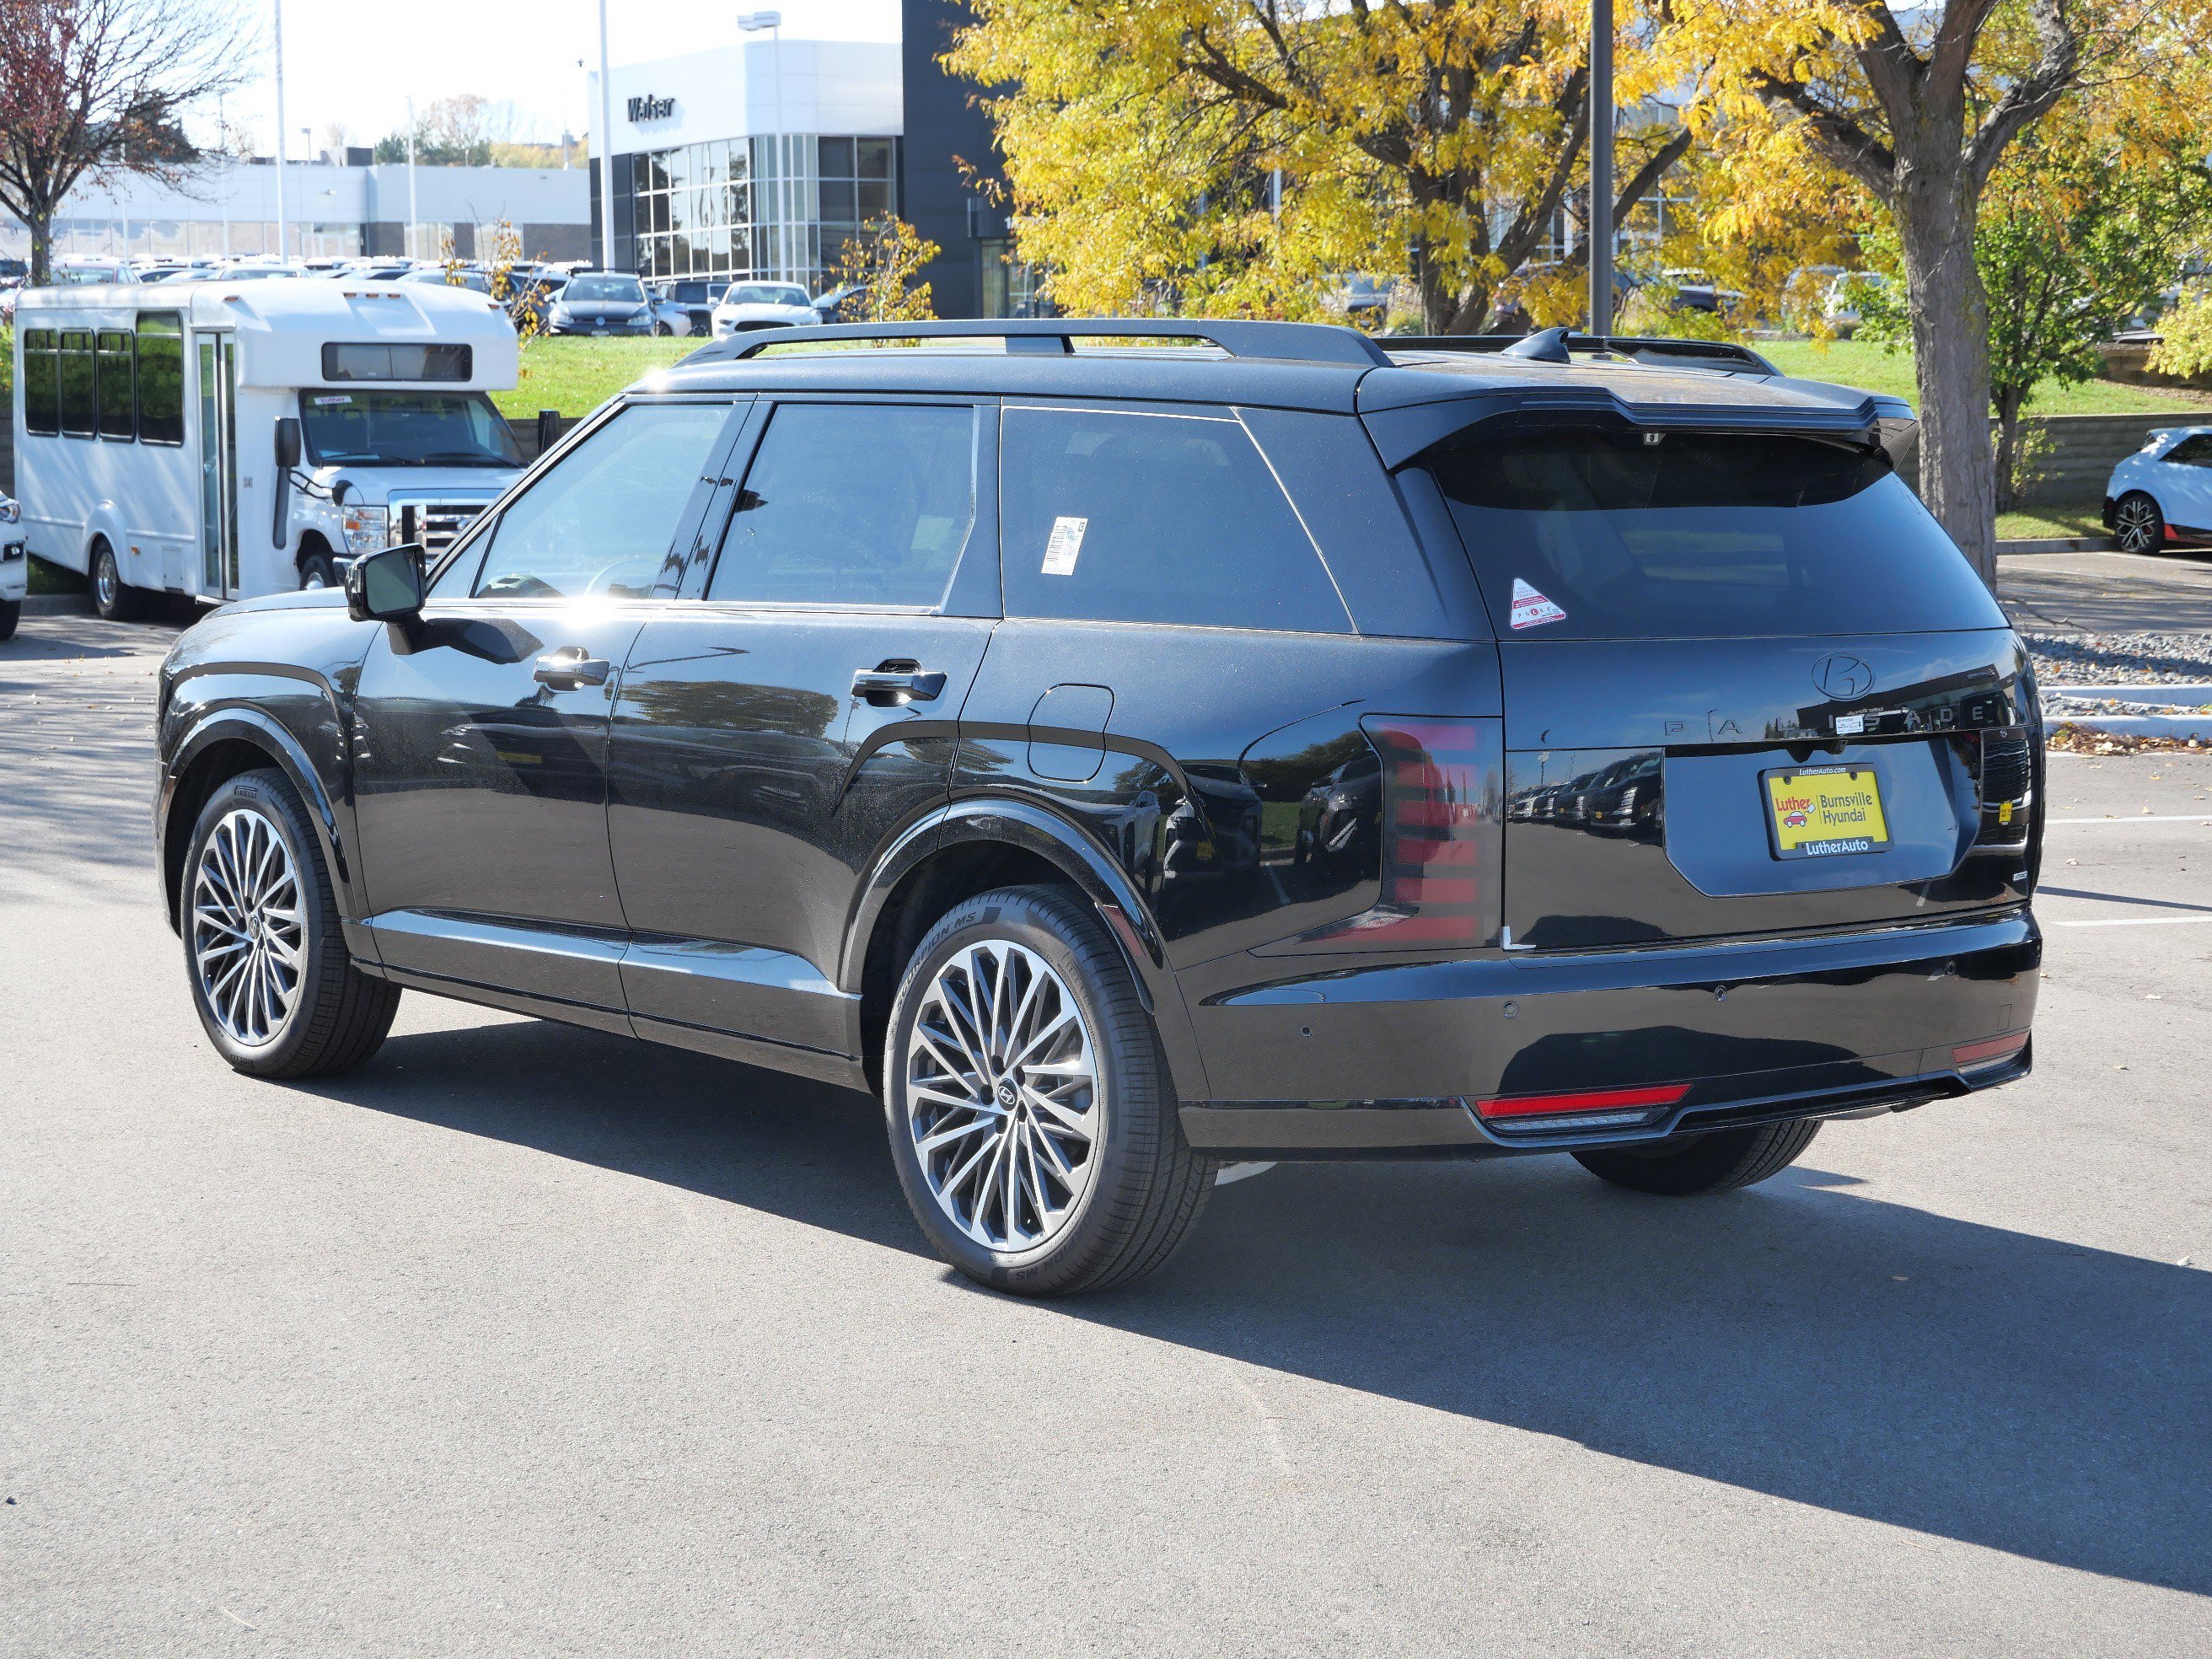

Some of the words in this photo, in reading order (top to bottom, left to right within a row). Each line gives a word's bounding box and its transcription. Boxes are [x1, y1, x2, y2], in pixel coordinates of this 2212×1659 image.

[628, 94, 675, 122] Walser
[1664, 706, 1984, 738] PALISADE
[1799, 767, 1846, 776] LutherAuto.com
[1774, 796, 1811, 812] Luther
[1819, 792, 1873, 809] Burnsville
[1822, 807, 1866, 826] Hyundai
[1805, 839, 1869, 856] LutherAuto
[896, 926, 953, 1009] SCORPION
[953, 911, 977, 929] MS
